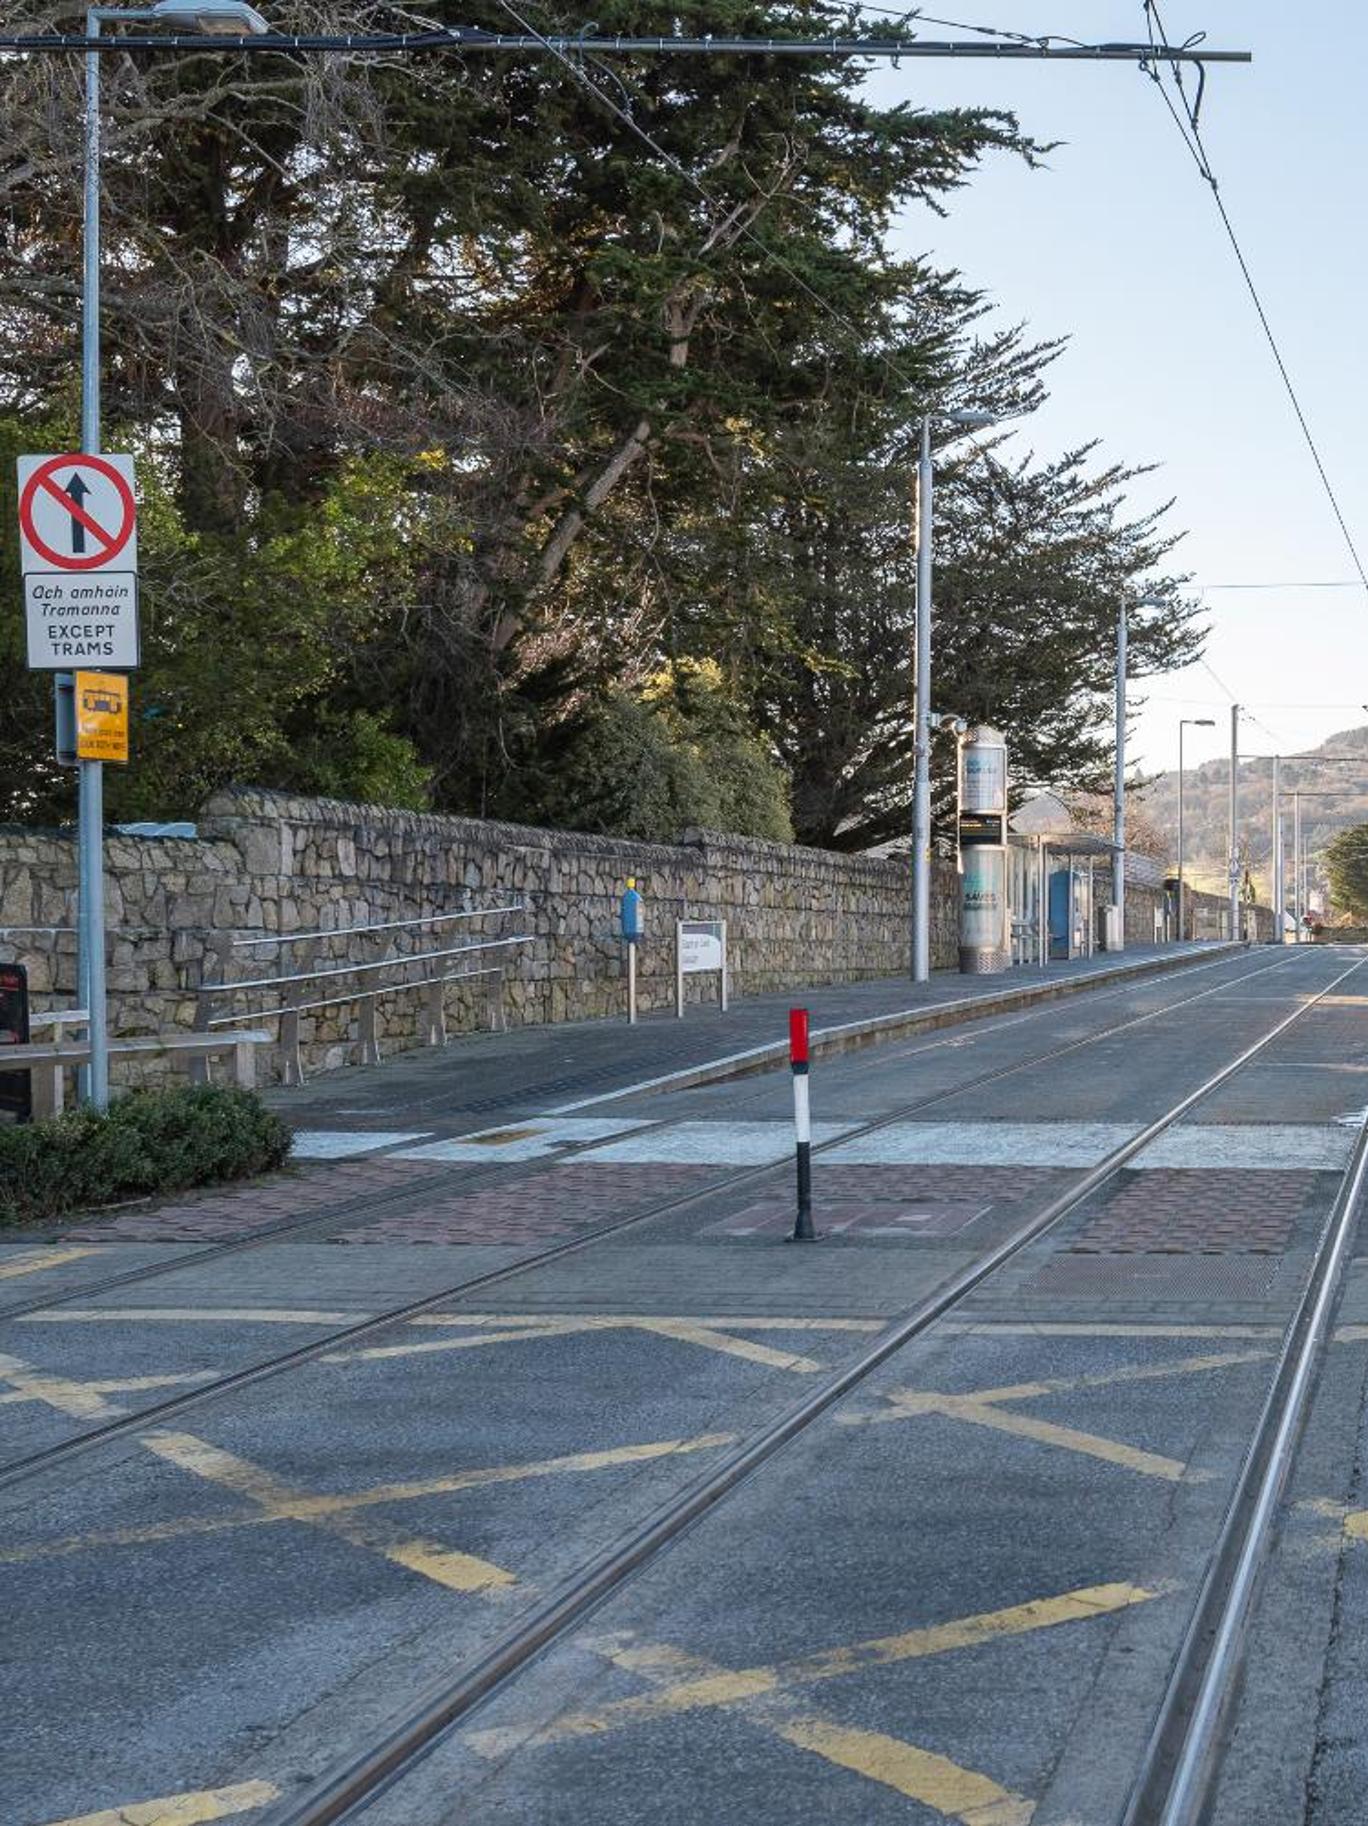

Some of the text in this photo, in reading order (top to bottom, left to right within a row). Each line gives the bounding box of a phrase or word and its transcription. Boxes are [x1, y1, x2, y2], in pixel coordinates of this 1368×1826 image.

[41, 603, 121, 617] Tramanna
[48, 624, 115, 639] EXCEPT
[51, 641, 114, 656] TRAMS
